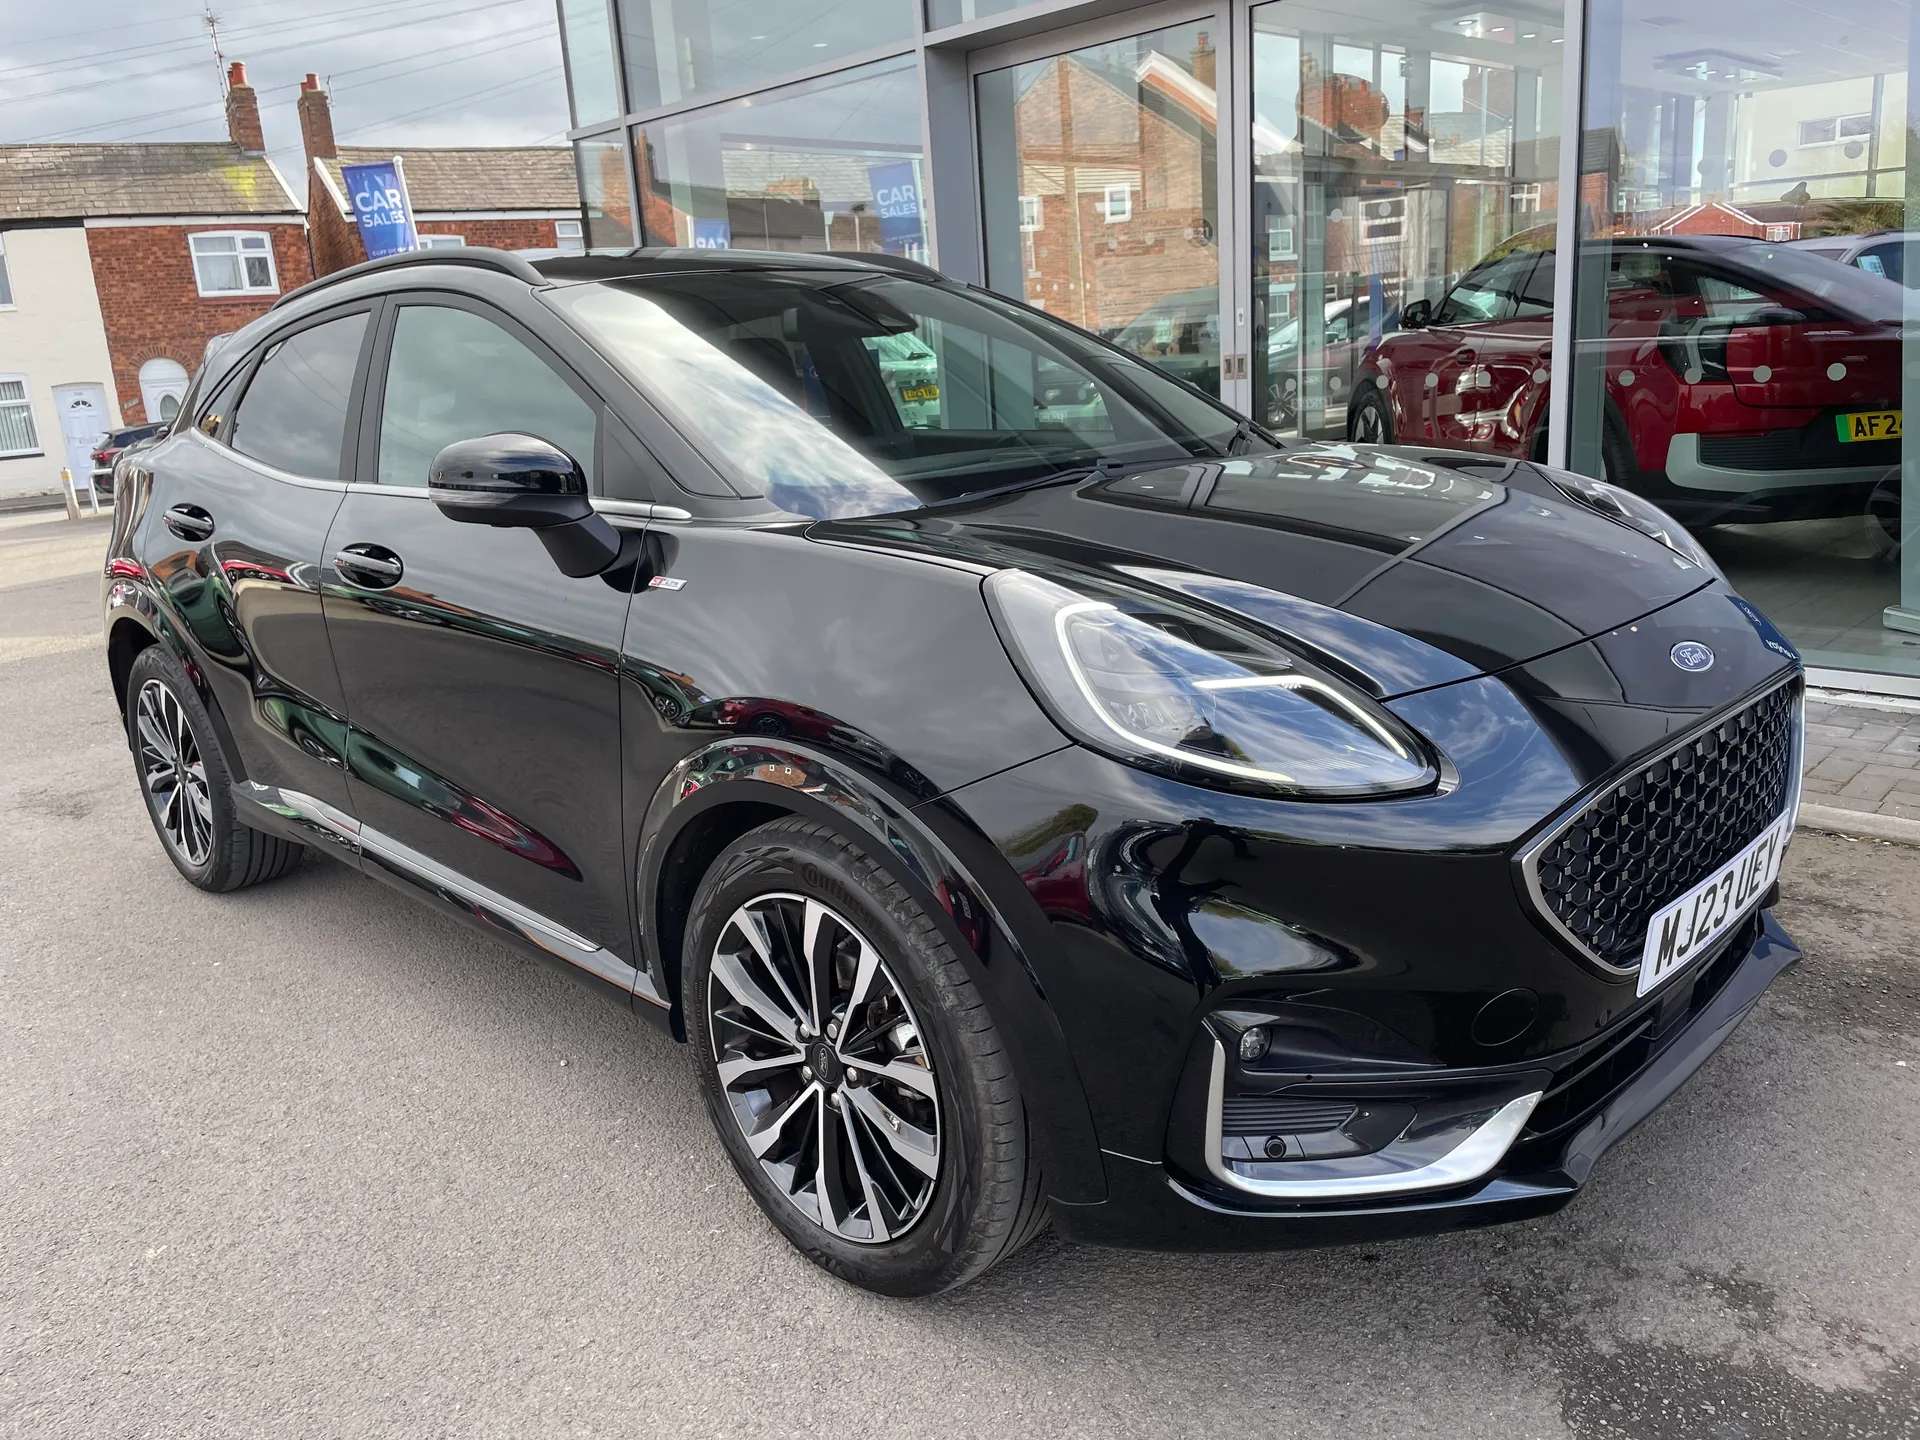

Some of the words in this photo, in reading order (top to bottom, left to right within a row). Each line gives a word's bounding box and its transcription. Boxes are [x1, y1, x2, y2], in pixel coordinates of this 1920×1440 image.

[355, 188, 402, 212] CAR
[877, 184, 915, 206] CAR
[362, 210, 406, 228] SALES
[880, 202, 918, 219] SALES
[1854, 414, 1902, 437] AF2
[1655, 870, 1734, 976] MJ23
[1735, 826, 1781, 910] UEY
